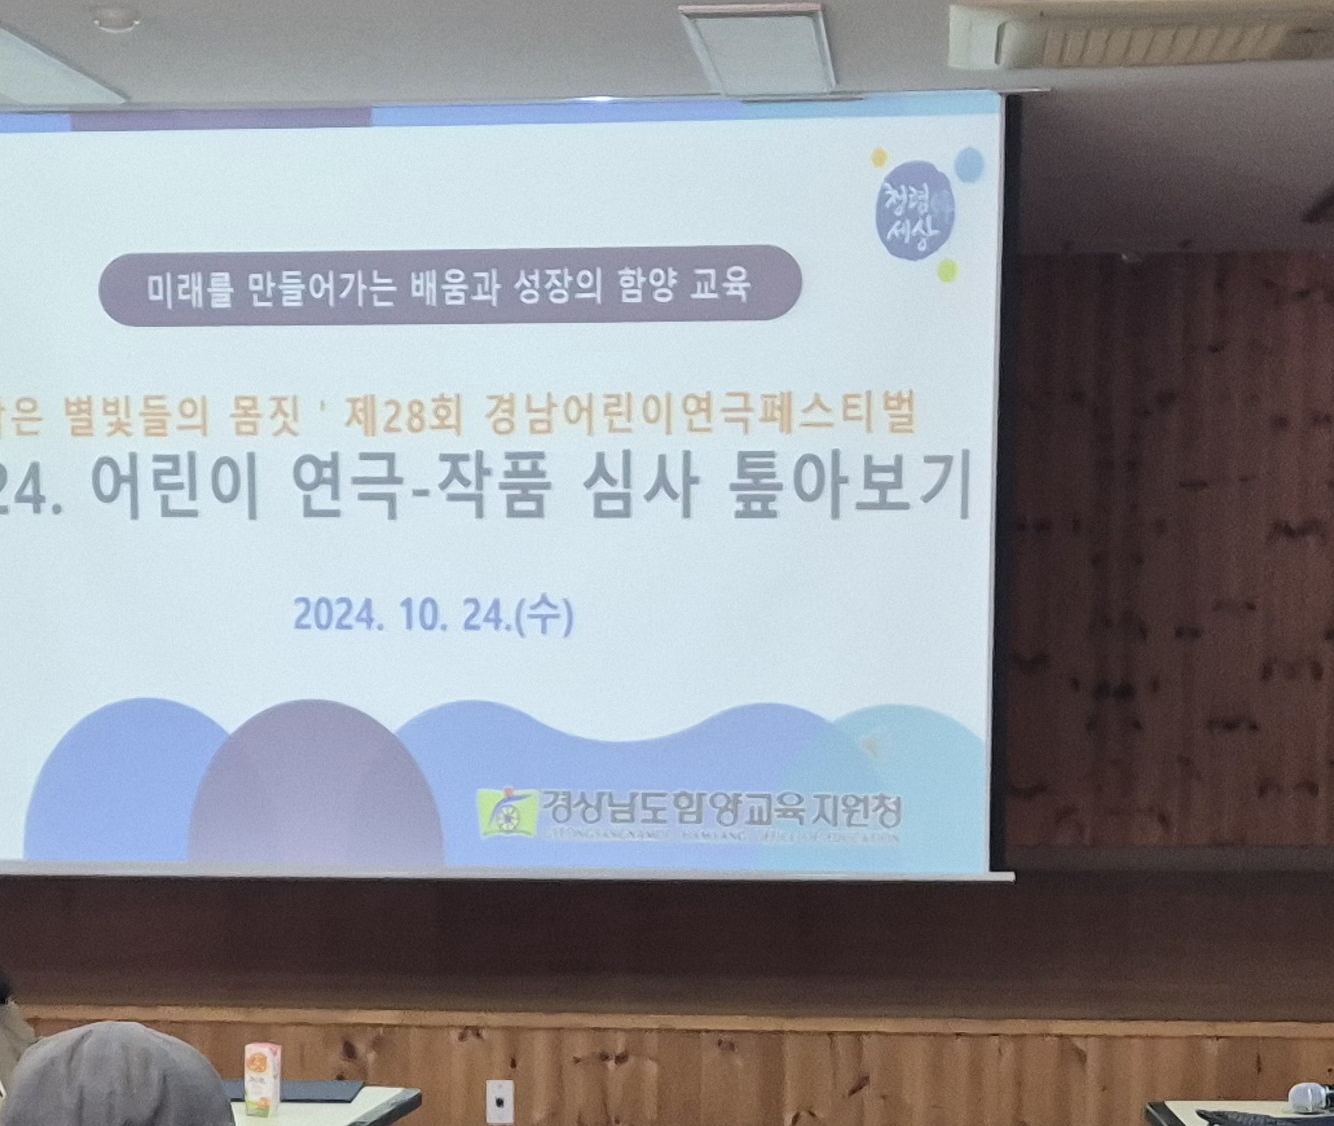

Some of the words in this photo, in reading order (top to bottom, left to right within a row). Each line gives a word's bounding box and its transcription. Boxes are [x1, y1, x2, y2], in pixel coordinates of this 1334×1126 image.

[886, 214, 942, 253] 세상
[147, 271, 236, 310] 미래를
[248, 269, 399, 309] 만들어가는
[410, 268, 503, 309] 배움과
[513, 266, 604, 306] 성장의
[617, 266, 679, 304] 함양
[690, 265, 753, 304] 교육
[63, 395, 210, 439] 별빛들의
[230, 394, 301, 438] 몸짓
[345, 394, 464, 439] 제28회
[485, 390, 917, 438] 경남어린이연극페스티벌
[91, 451, 259, 521] 어린이
[292, 449, 555, 522] 연극-작품
[582, 448, 702, 521] 심사
[728, 448, 972, 521] 톺아보기
[293, 596, 386, 632] 2024.
[399, 596, 449, 632] 10.
[462, 592, 575, 640] 24.(수)
